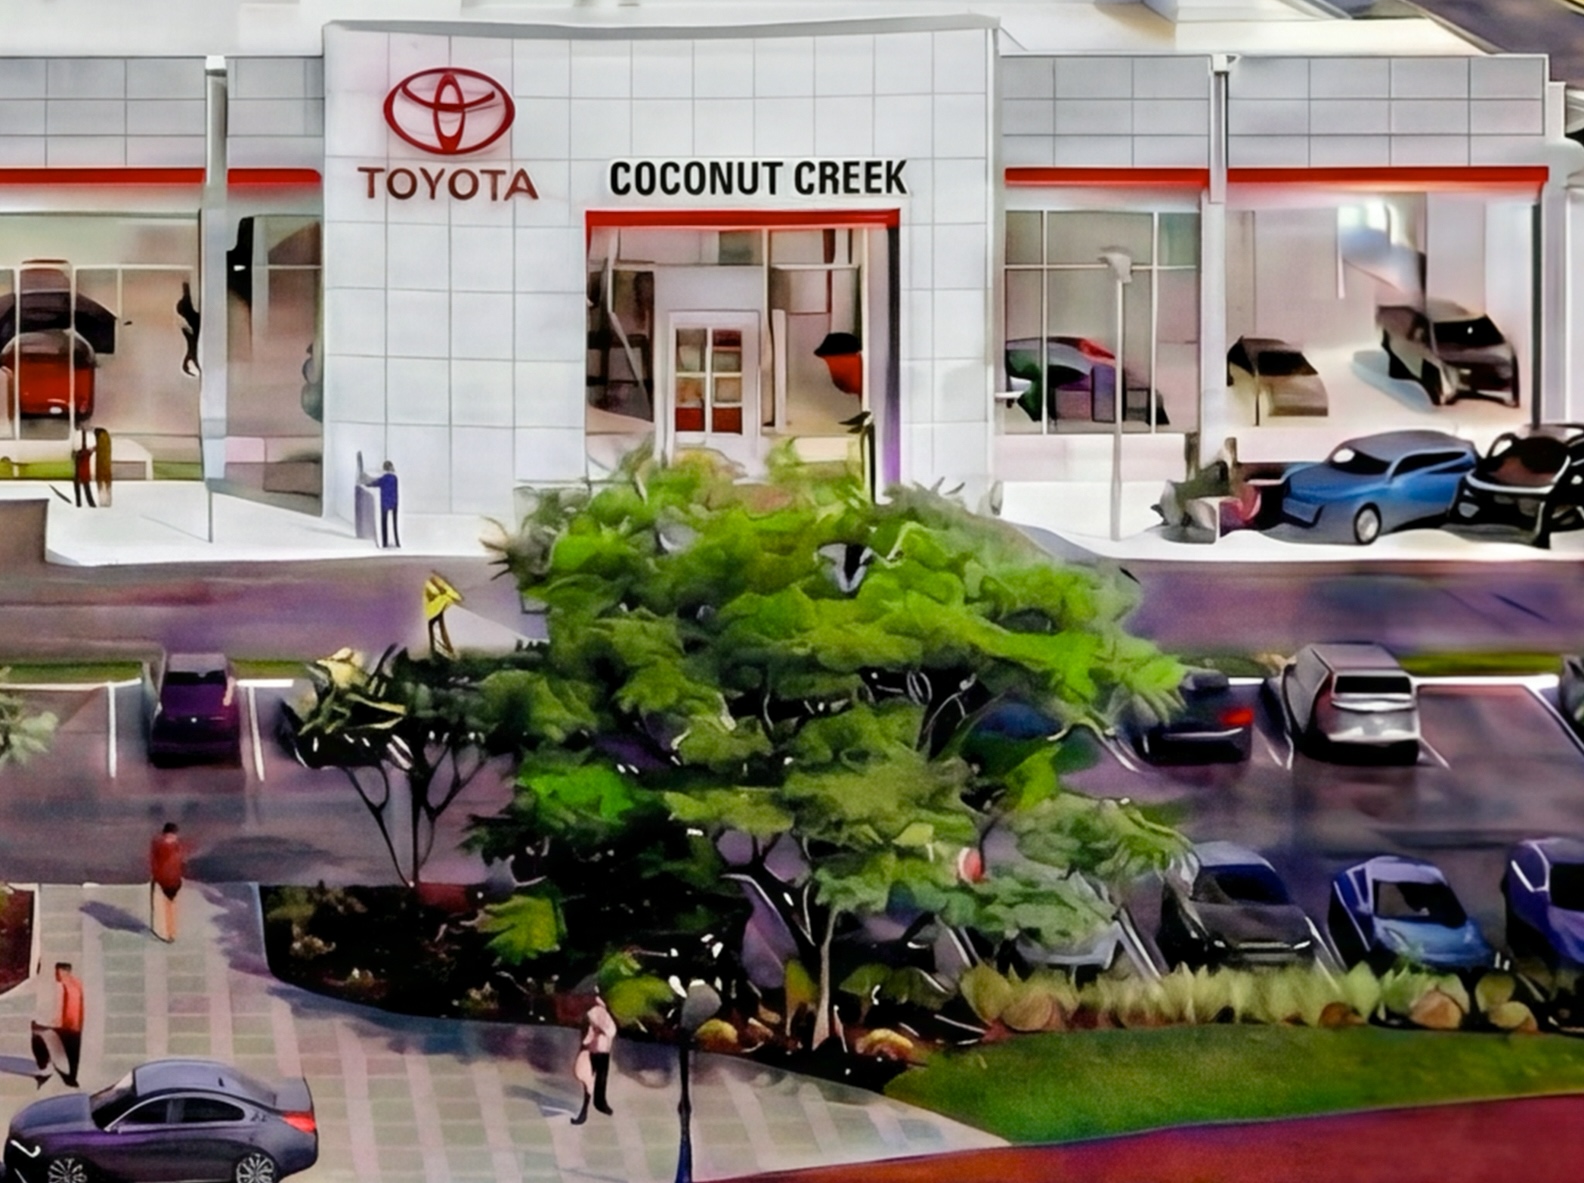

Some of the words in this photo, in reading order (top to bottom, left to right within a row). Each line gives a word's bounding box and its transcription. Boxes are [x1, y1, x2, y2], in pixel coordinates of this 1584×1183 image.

[357, 166, 539, 201] TOYOTA
[609, 160, 784, 197] COCONUT
[793, 159, 908, 197] CREEK
